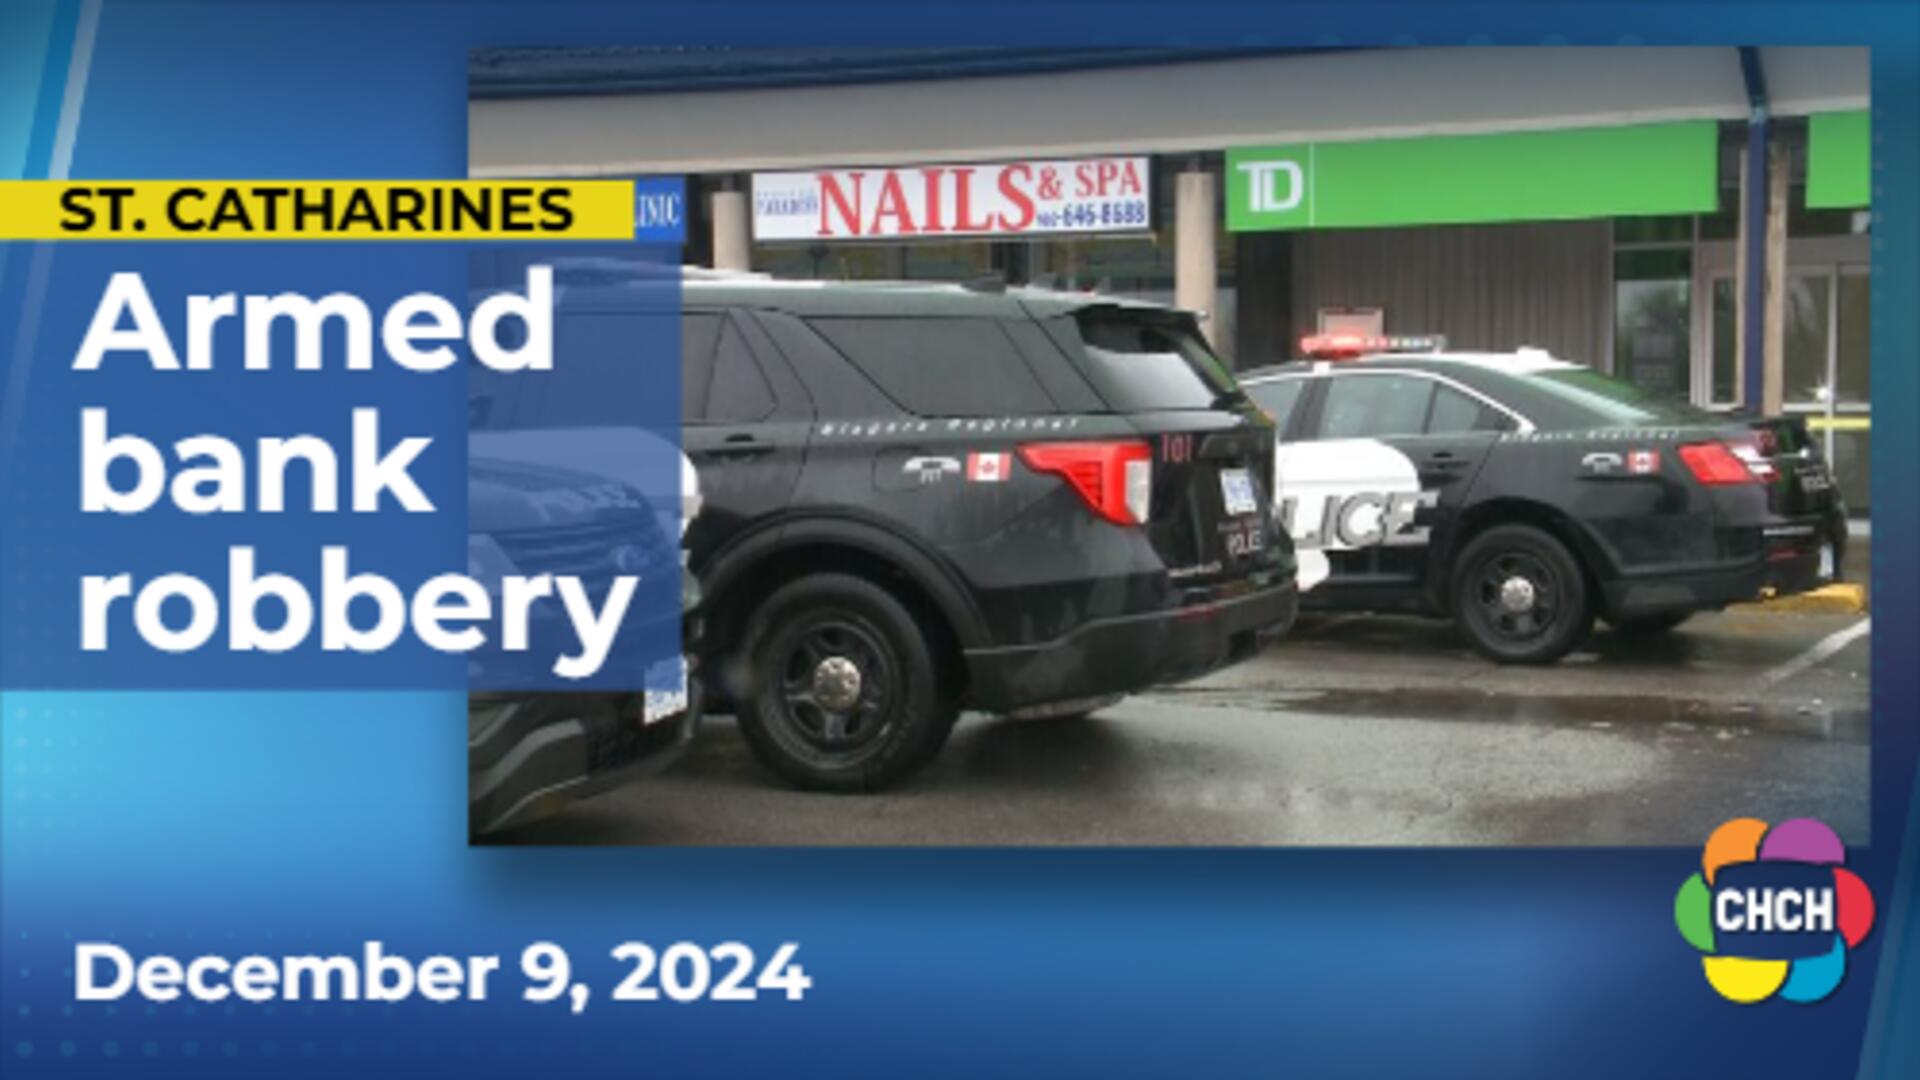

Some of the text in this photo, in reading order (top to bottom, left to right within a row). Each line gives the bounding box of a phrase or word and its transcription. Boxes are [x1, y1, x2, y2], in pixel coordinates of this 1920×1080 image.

[634, 194, 682, 228] INIC
[816, 160, 1141, 235] NAILS & SPA
[1236, 161, 1303, 211] TD
[1272, 488, 1442, 551] LICE
